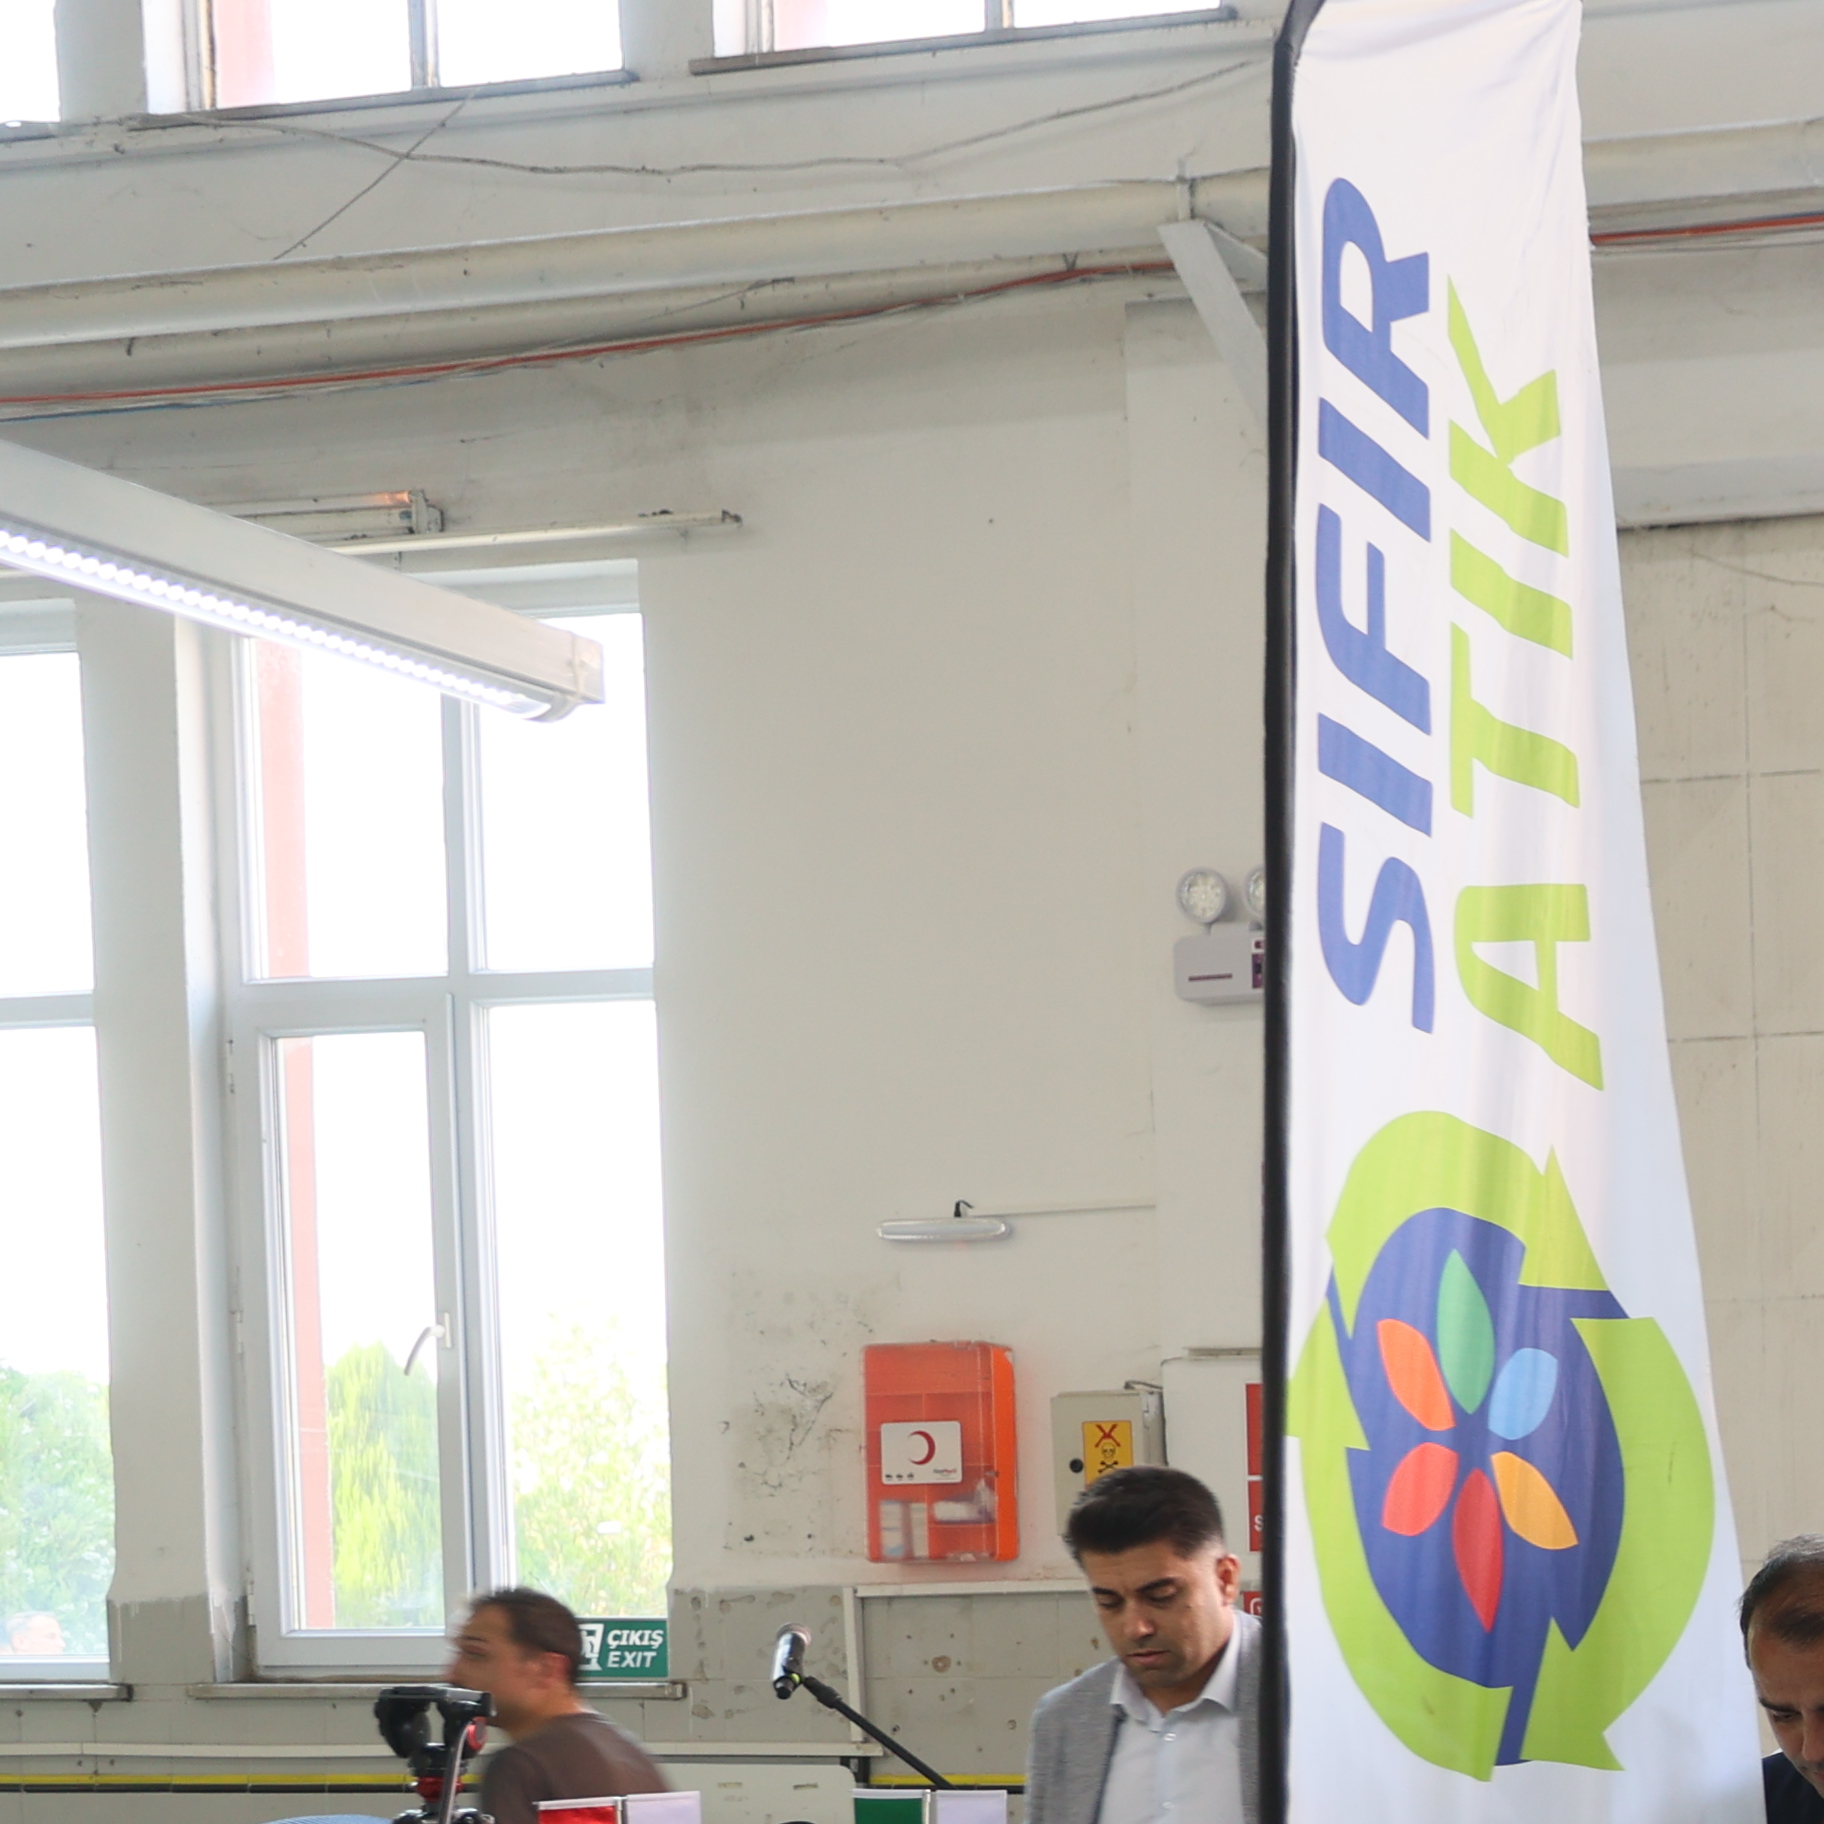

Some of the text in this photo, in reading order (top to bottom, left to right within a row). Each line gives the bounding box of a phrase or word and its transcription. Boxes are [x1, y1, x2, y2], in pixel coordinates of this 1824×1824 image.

[1317, 178, 1434, 1033] SIFIR
[1448, 274, 1603, 1091] ATIK
[606, 1629, 664, 1649] ÇIKIŞ
[606, 1650, 657, 1668] EXIT
